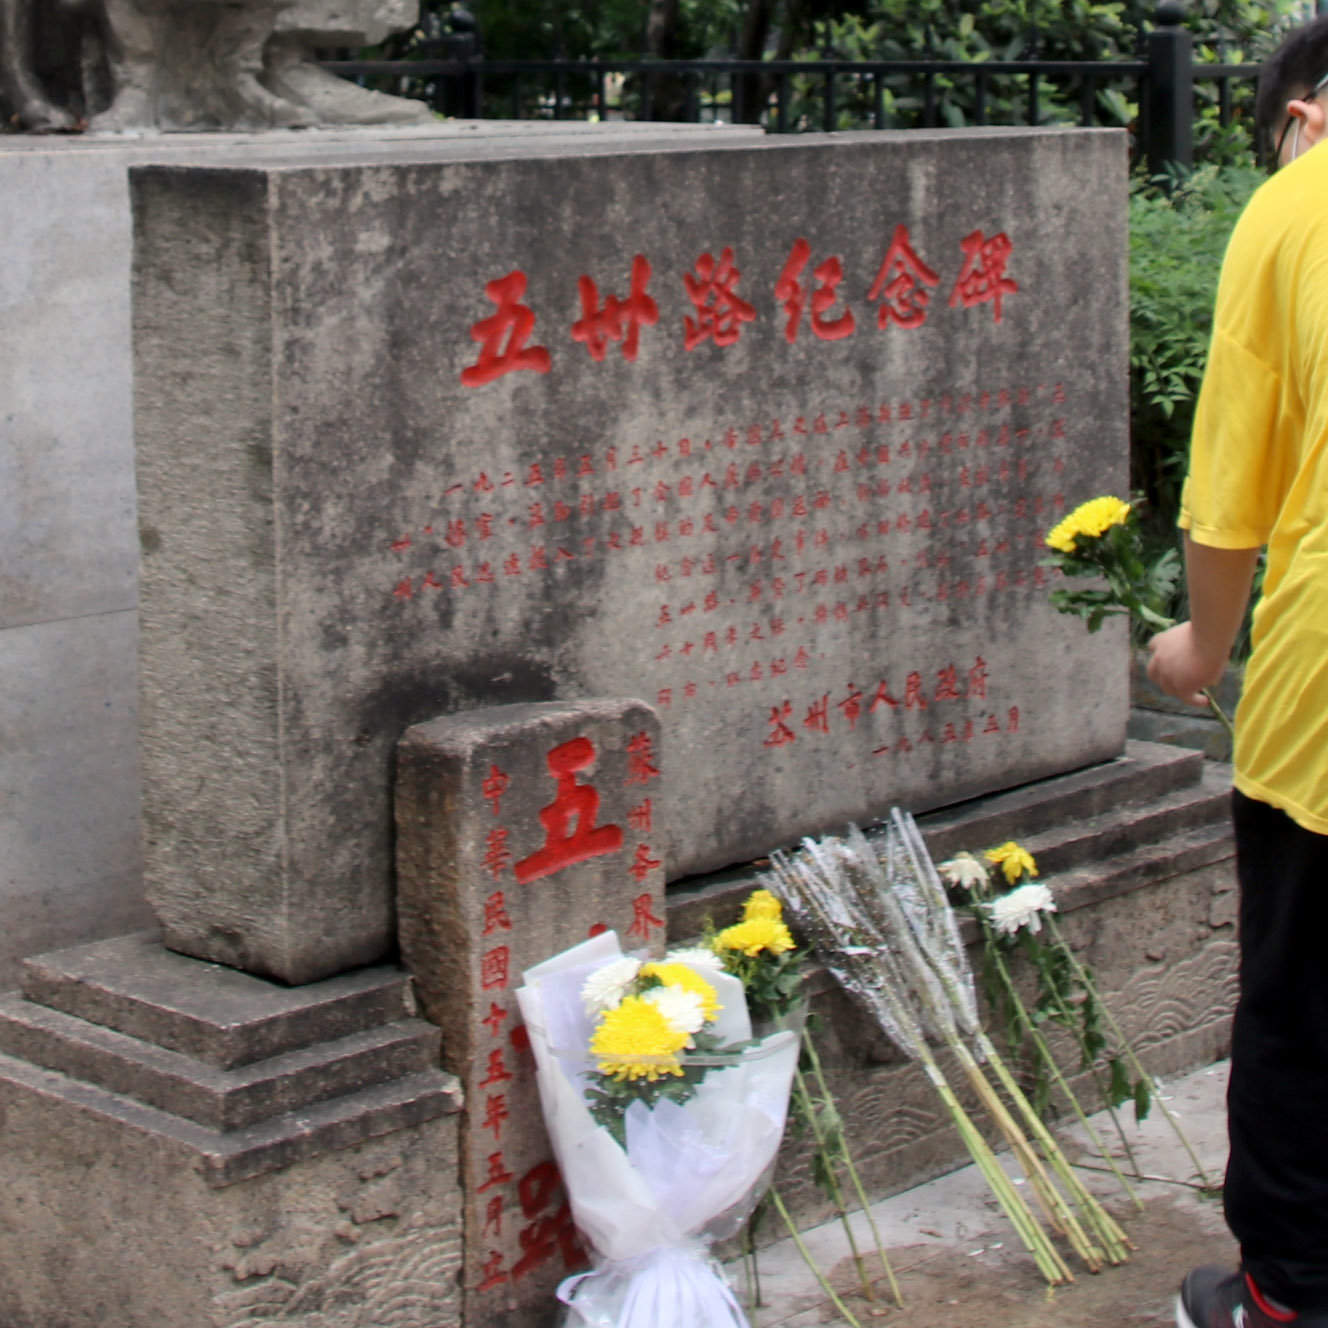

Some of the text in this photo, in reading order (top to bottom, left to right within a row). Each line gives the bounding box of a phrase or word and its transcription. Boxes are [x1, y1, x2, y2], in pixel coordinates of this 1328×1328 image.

[460, 224, 1018, 387] 五卅路纪念碑
[763, 655, 989, 749] 苏州市人民政府
